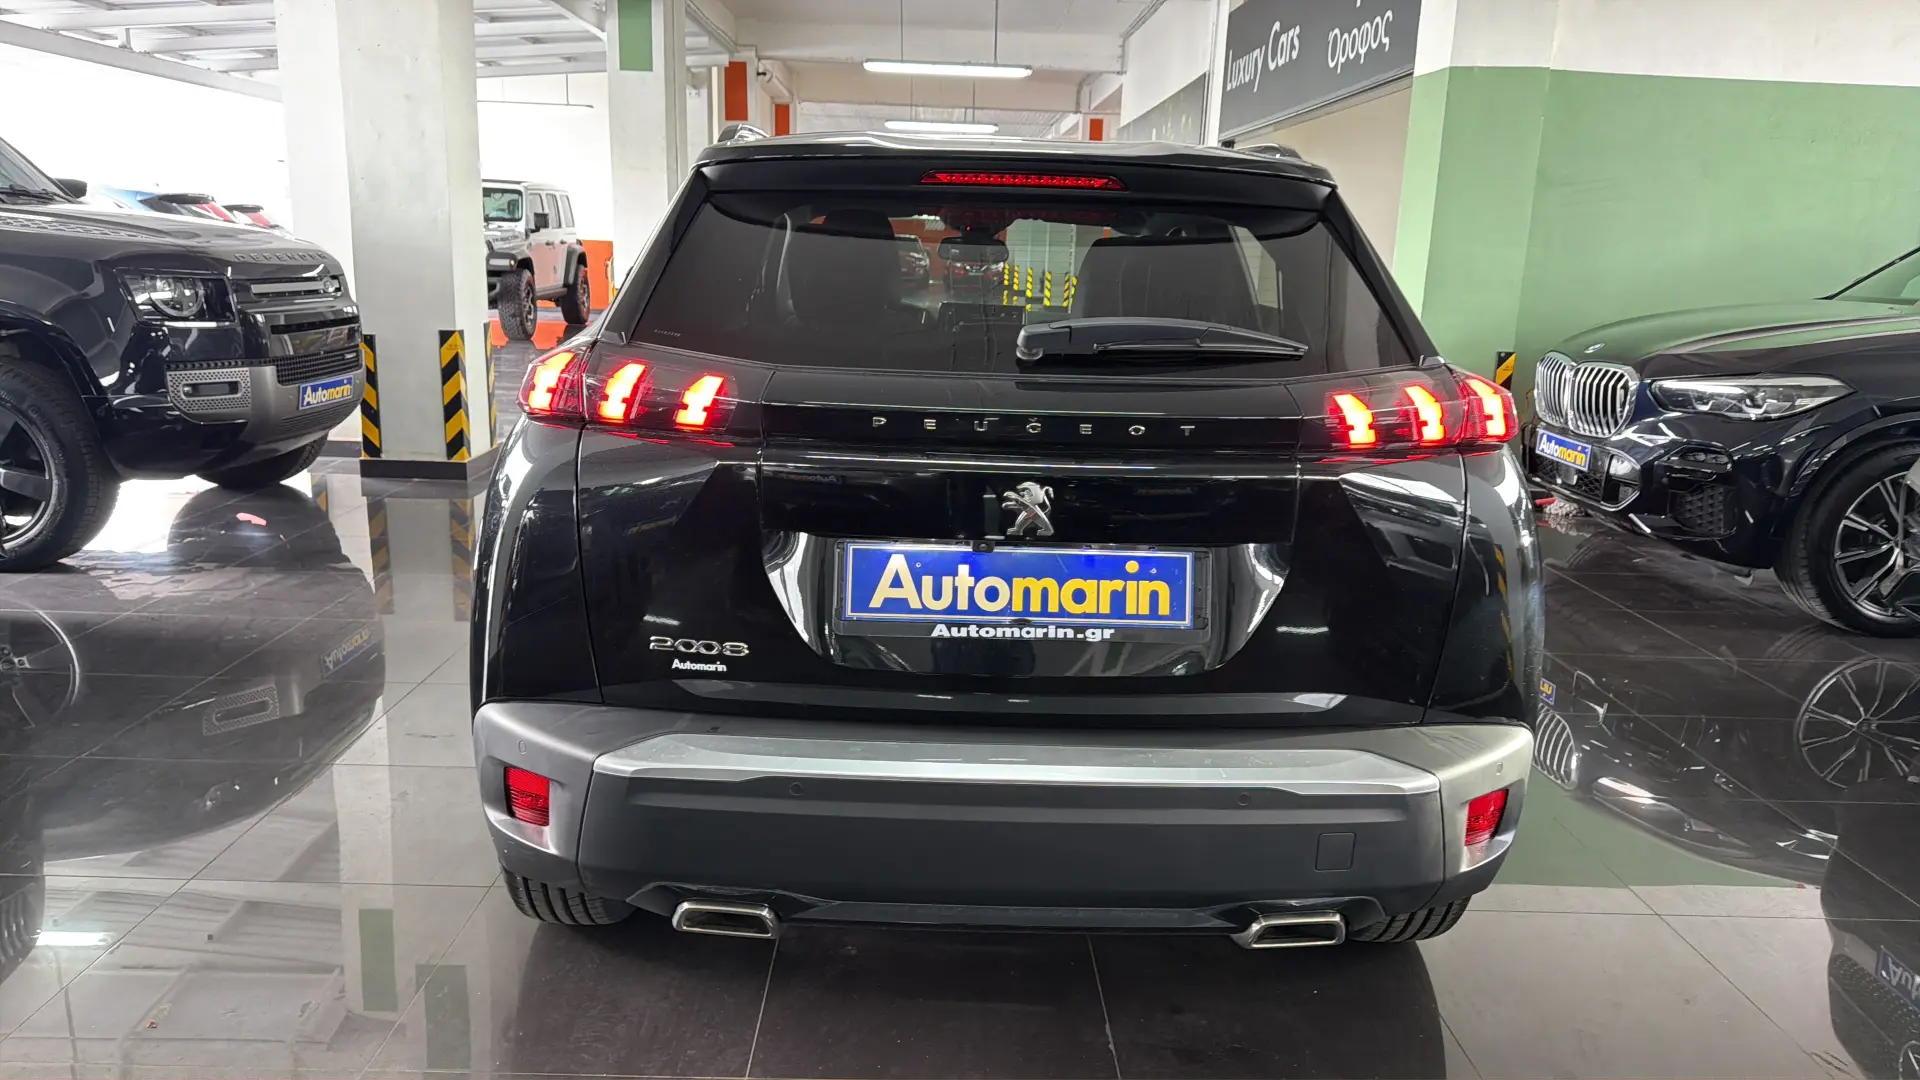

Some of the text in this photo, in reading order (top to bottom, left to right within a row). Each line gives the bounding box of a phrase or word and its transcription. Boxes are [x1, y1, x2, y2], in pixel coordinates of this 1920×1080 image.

[1327, 10, 1393, 75] Όροφος
[1226, 20, 1301, 93] Luxury Cars
[233, 252, 329, 262] DEFENDER
[303, 379, 353, 406] Automarin
[872, 416, 1196, 437] PEUGEOT
[1539, 433, 1587, 467] Automarin
[868, 553, 1171, 616] Automarin
[930, 623, 1115, 642] Automarin.gr
[649, 635, 750, 656] 2008
[671, 658, 728, 672] Automarin
